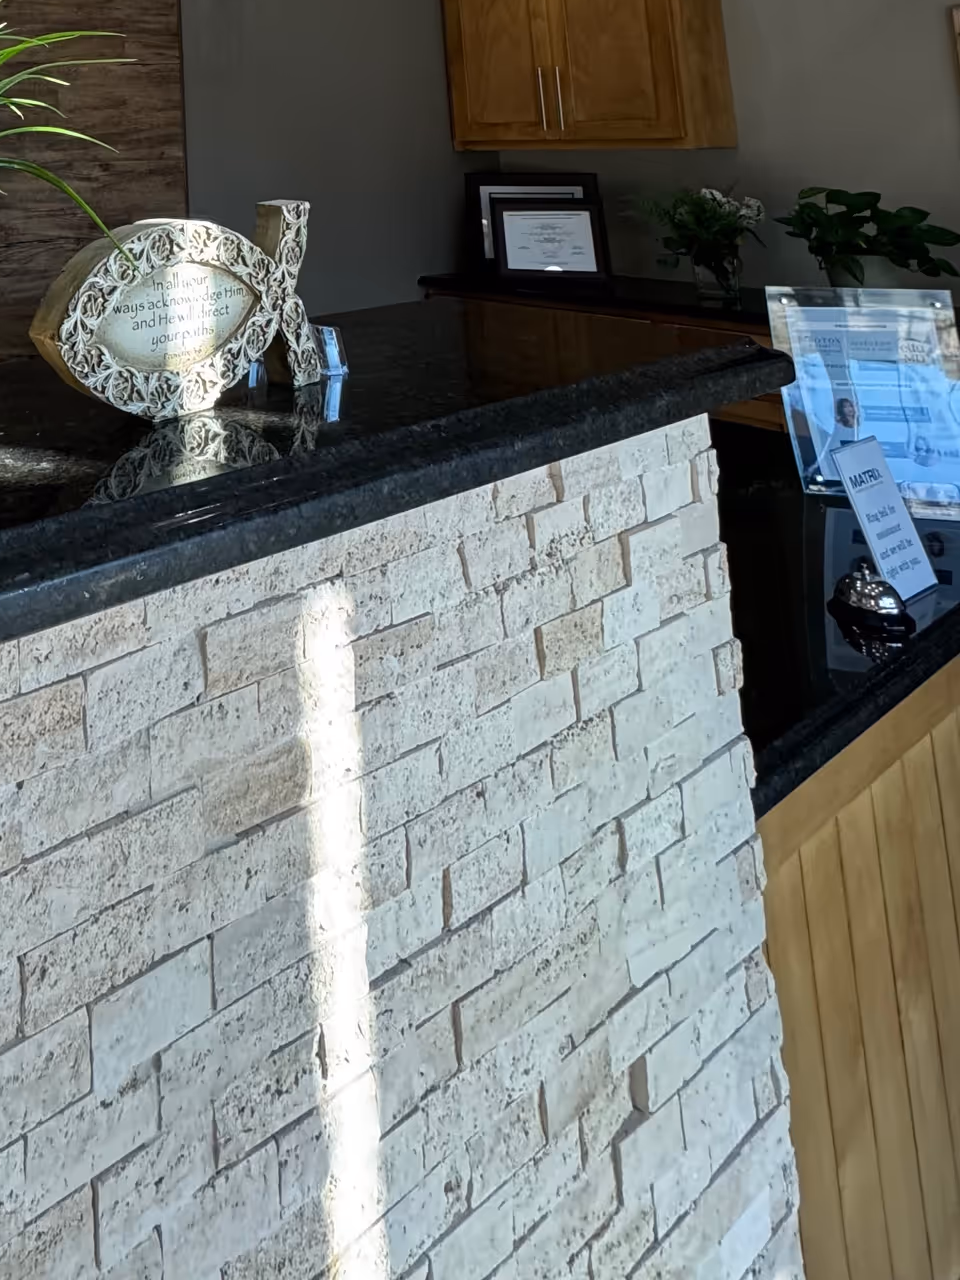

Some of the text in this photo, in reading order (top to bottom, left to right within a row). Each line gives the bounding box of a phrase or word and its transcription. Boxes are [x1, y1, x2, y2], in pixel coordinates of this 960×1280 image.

[152, 279, 164, 292] In
[165, 272, 179, 289] all
[112, 301, 145, 319] ways
[147, 286, 222, 311] acknowdge
[132, 303, 230, 331] and He will direct
[151, 332, 181, 352] your
